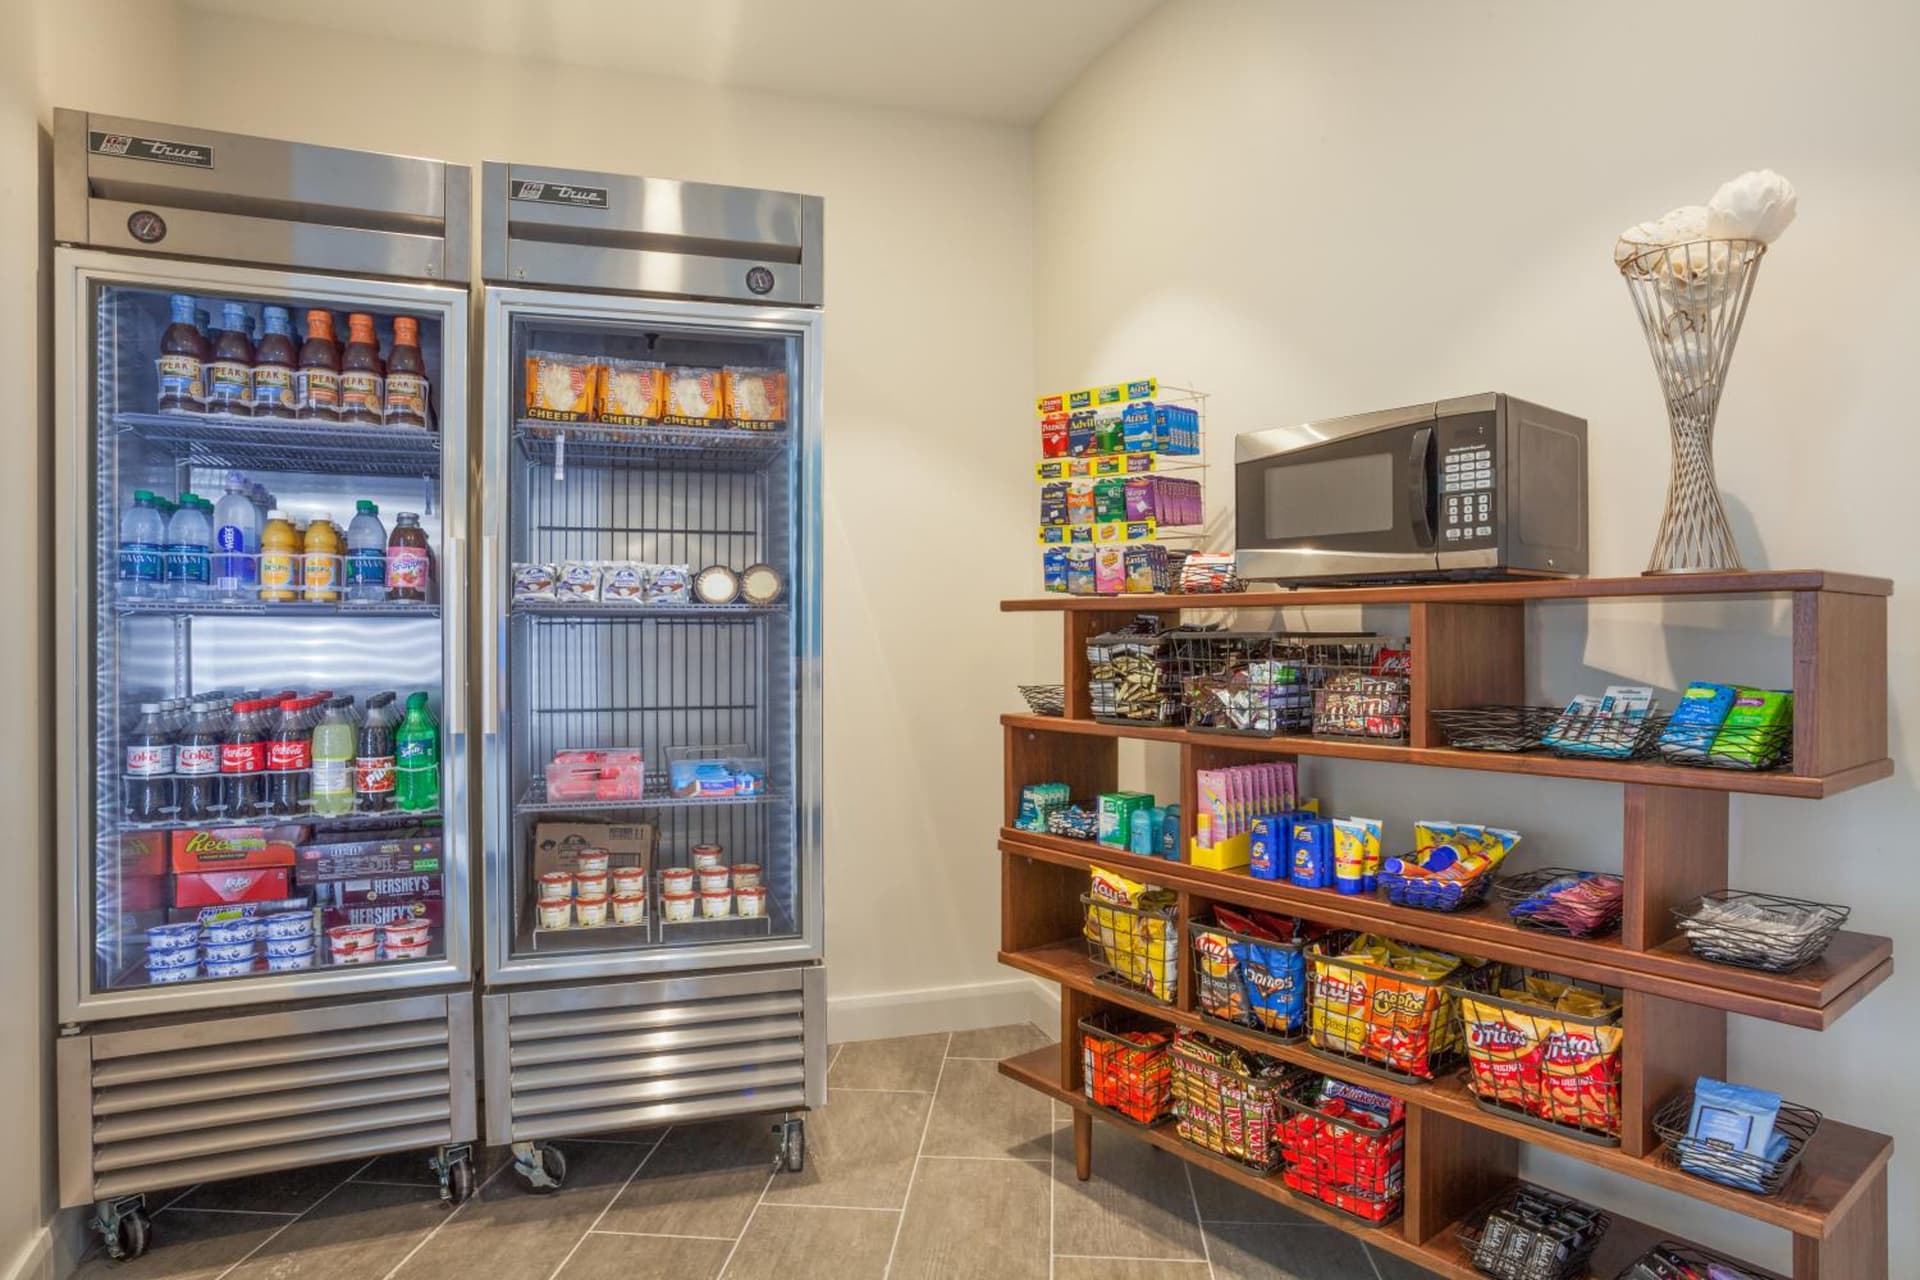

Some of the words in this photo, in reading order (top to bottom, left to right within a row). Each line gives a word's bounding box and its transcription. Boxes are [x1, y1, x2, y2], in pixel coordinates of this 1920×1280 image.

[215, 366, 242, 377] PEAK
[255, 369, 280, 379] PEAK
[528, 408, 577, 422] CHEESE
[601, 414, 649, 427] CHEESE
[663, 416, 711, 428] CHEESE
[1071, 417, 1095, 430] Advil
[120, 552, 157, 564] DASANI
[168, 553, 201, 564] DASANI
[181, 749, 214, 762] Coke
[374, 875, 430, 895] HERSHEY'S
[350, 905, 415, 925] HERSHEY'S
[1374, 989, 1425, 1014] Cheetos
[1471, 1020, 1528, 1047] Fritos
[1545, 1032, 1600, 1060] Fritos
[1493, 1063, 1525, 1072] ORIGINAL
